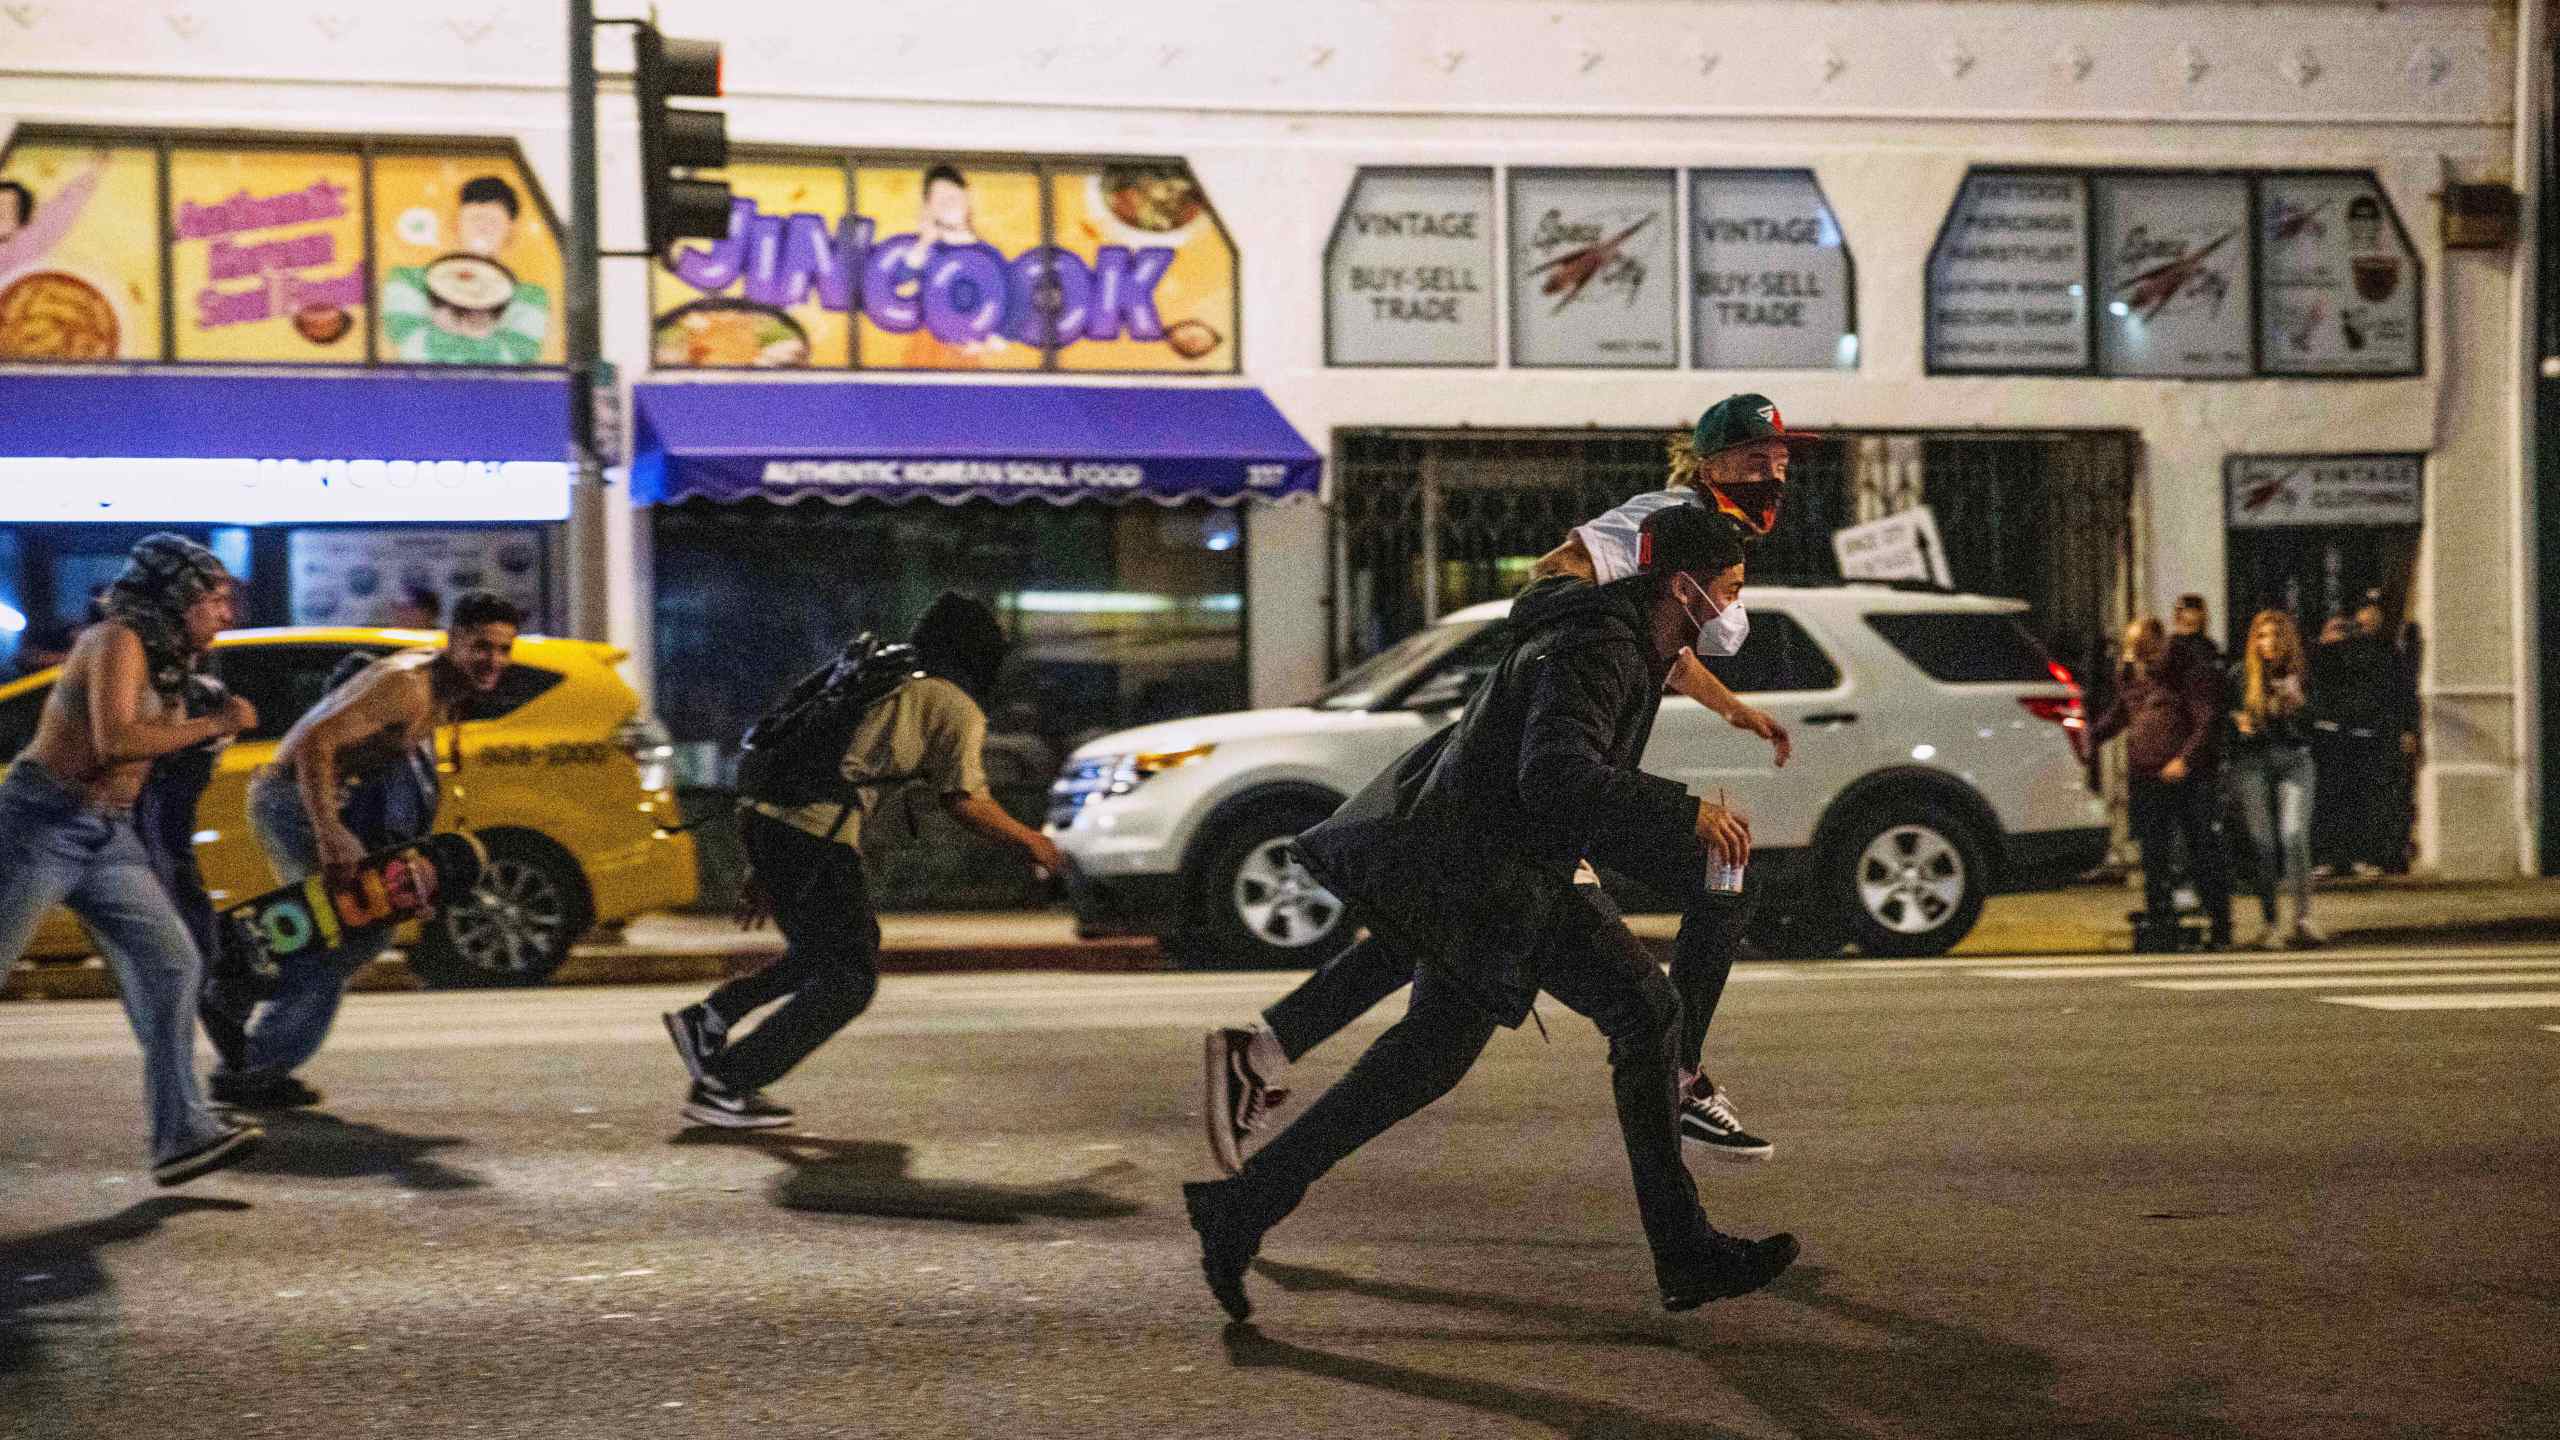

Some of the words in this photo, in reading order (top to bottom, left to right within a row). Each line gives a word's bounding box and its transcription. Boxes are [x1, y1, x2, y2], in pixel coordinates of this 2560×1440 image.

[1352, 212, 1477, 240] VINTAGE
[1698, 217, 1822, 245] VINTAGE
[1371, 296, 1458, 322] TRADE
[1714, 302, 1805, 328] TRADE
[763, 461, 900, 486] AUTHENTIC
[902, 461, 1003, 486] KOREAN
[1005, 462, 1071, 486] SOUL
[1072, 463, 1143, 487] FOOD
